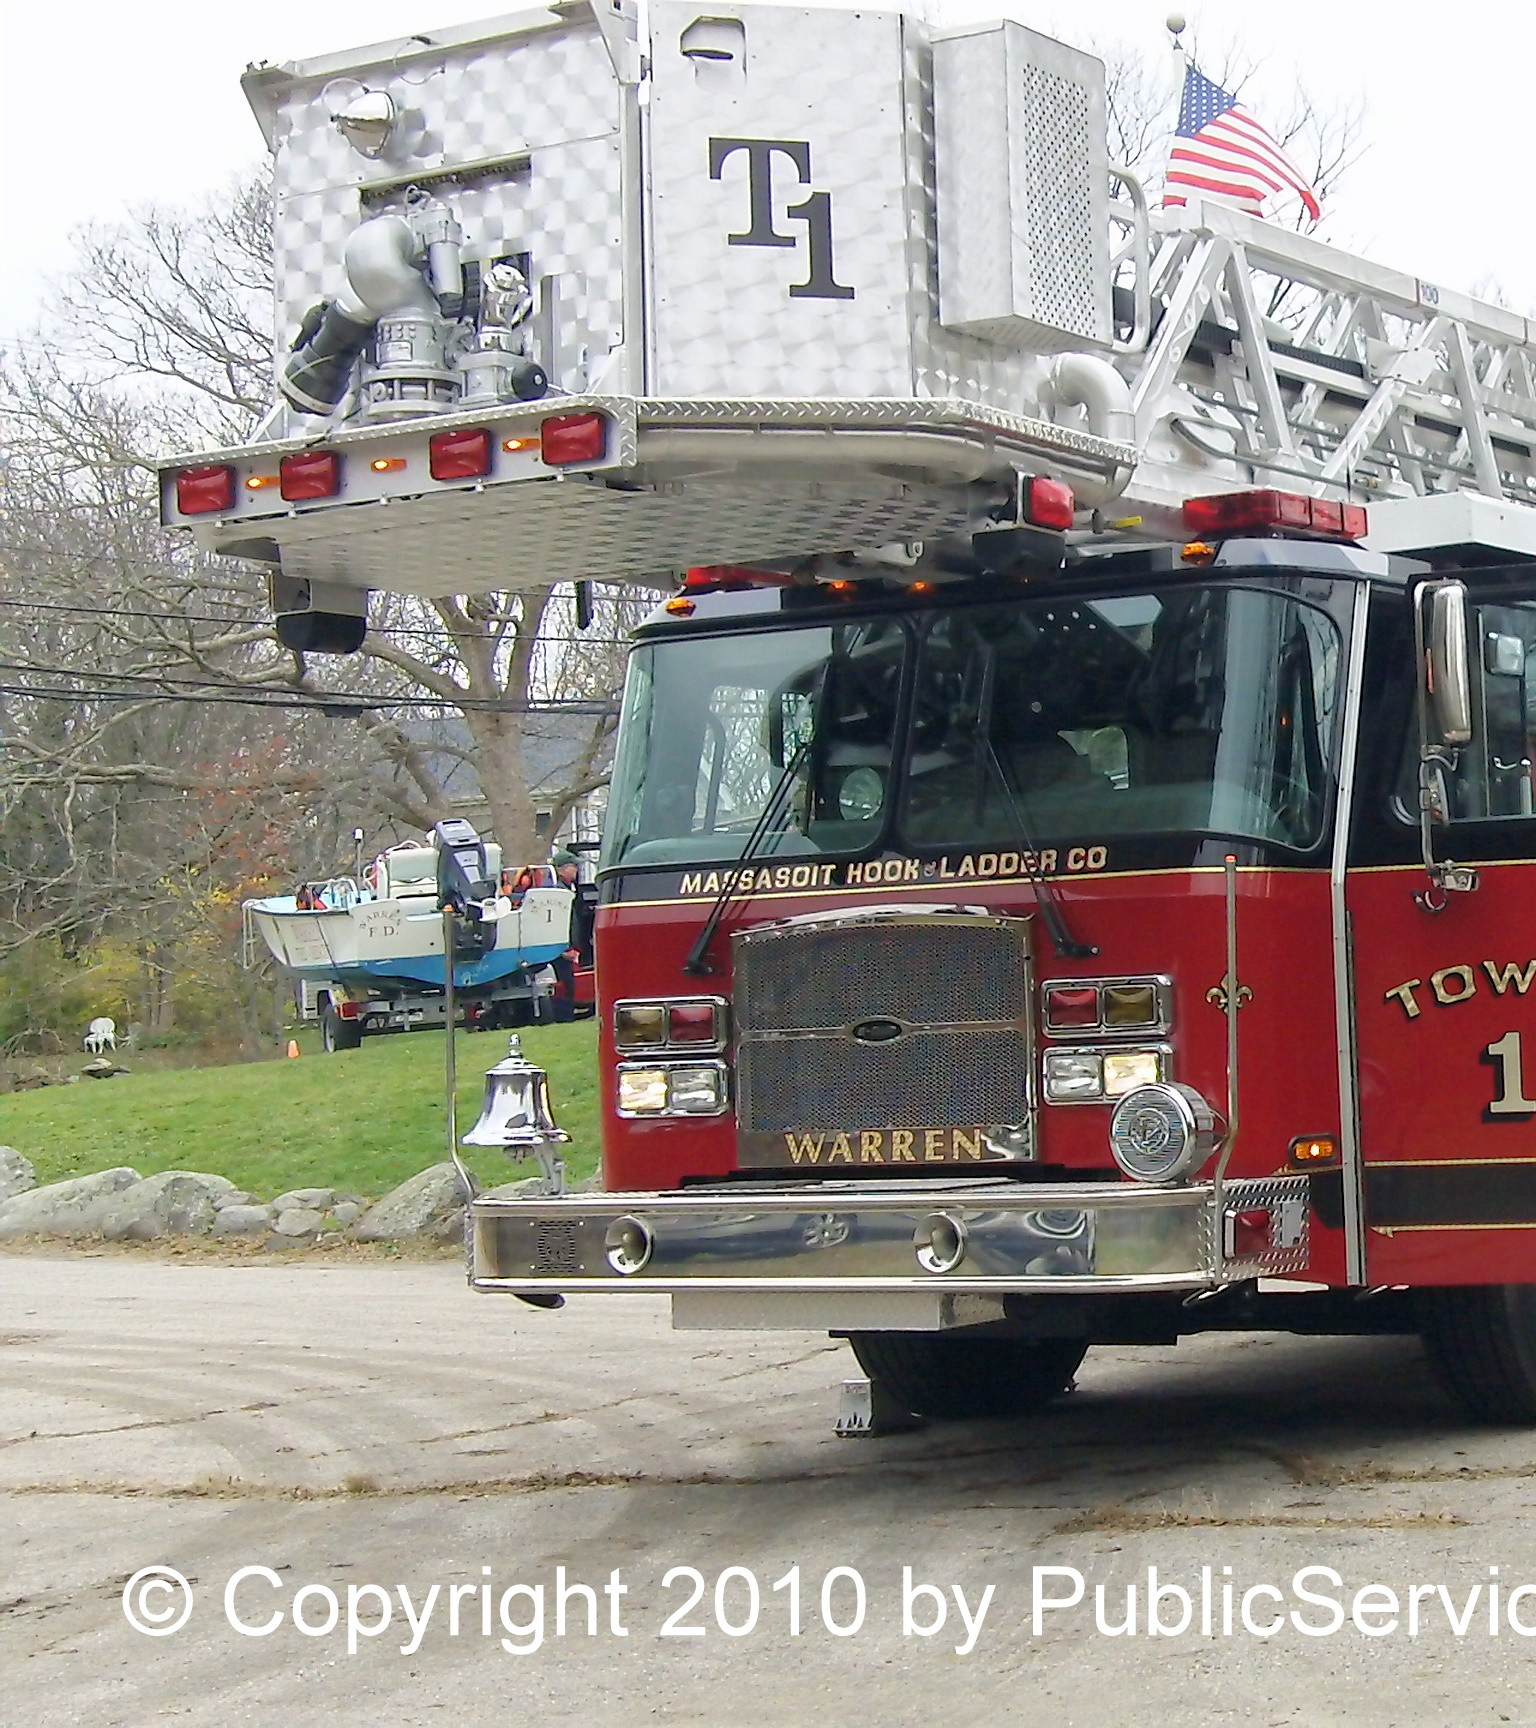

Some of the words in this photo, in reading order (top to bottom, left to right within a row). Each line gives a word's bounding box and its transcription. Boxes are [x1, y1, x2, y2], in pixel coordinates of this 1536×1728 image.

[680, 864, 836, 894] MASSASOIT
[847, 858, 920, 885] HOOK
[940, 849, 1057, 878] LADDER
[1067, 846, 1109, 871] CO
[784, 1128, 983, 1165] WARREN
